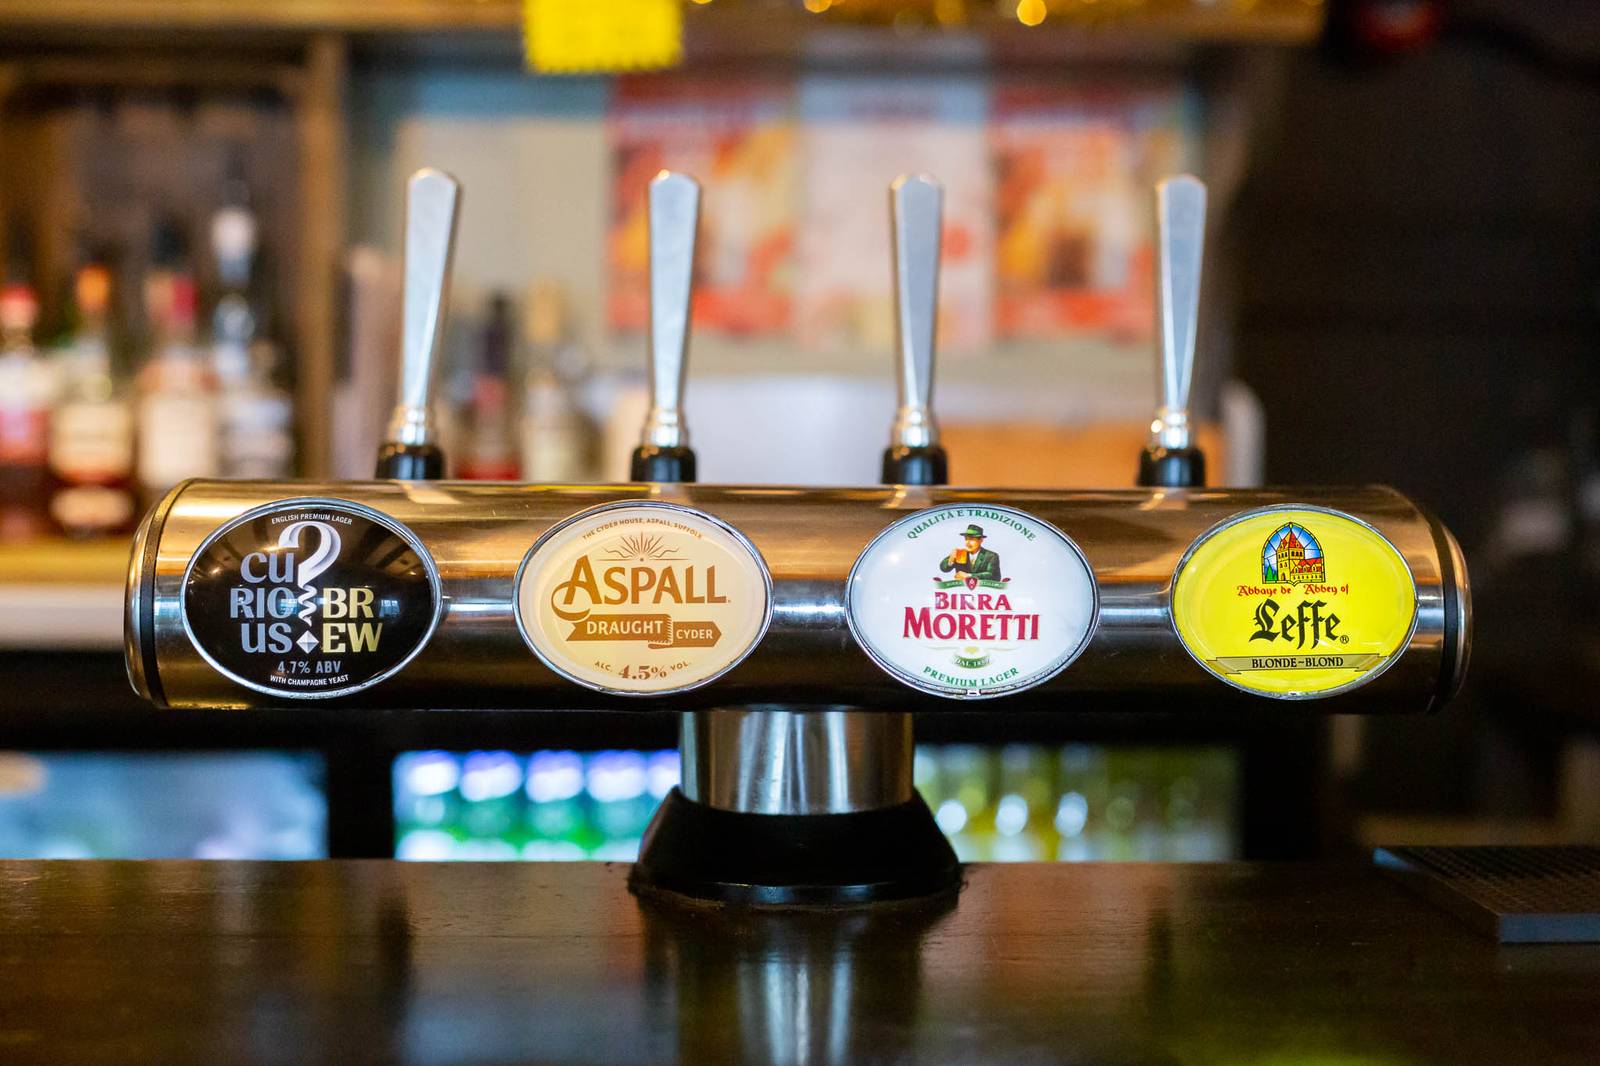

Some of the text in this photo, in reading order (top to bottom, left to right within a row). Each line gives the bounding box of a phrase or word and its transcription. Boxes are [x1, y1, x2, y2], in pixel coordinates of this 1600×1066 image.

[271, 514, 299, 524] ENGLISH
[332, 514, 353, 526] LAGER
[582, 530, 595, 540] THE
[596, 520, 618, 533] CYDER
[956, 510, 966, 518] E
[967, 509, 1037, 542] TRADIZIONE
[551, 555, 727, 621] ASPALL
[1236, 584, 1292, 598] Abbaye de
[1303, 583, 1350, 596] Abbey of
[230, 586, 295, 619] RIO
[322, 586, 374, 619] BR
[934, 592, 1012, 610] BIRRA
[586, 620, 714, 640] DRAUGHT CYDER
[903, 606, 1040, 640] MORETTI
[322, 622, 384, 653] EW
[277, 660, 342, 674] 4.7% ABV
[618, 664, 668, 680] 4.5%
[922, 666, 1019, 687] PREMIUM LAGER
[270, 674, 349, 686] WITH CHAMPAGNE YEAST
